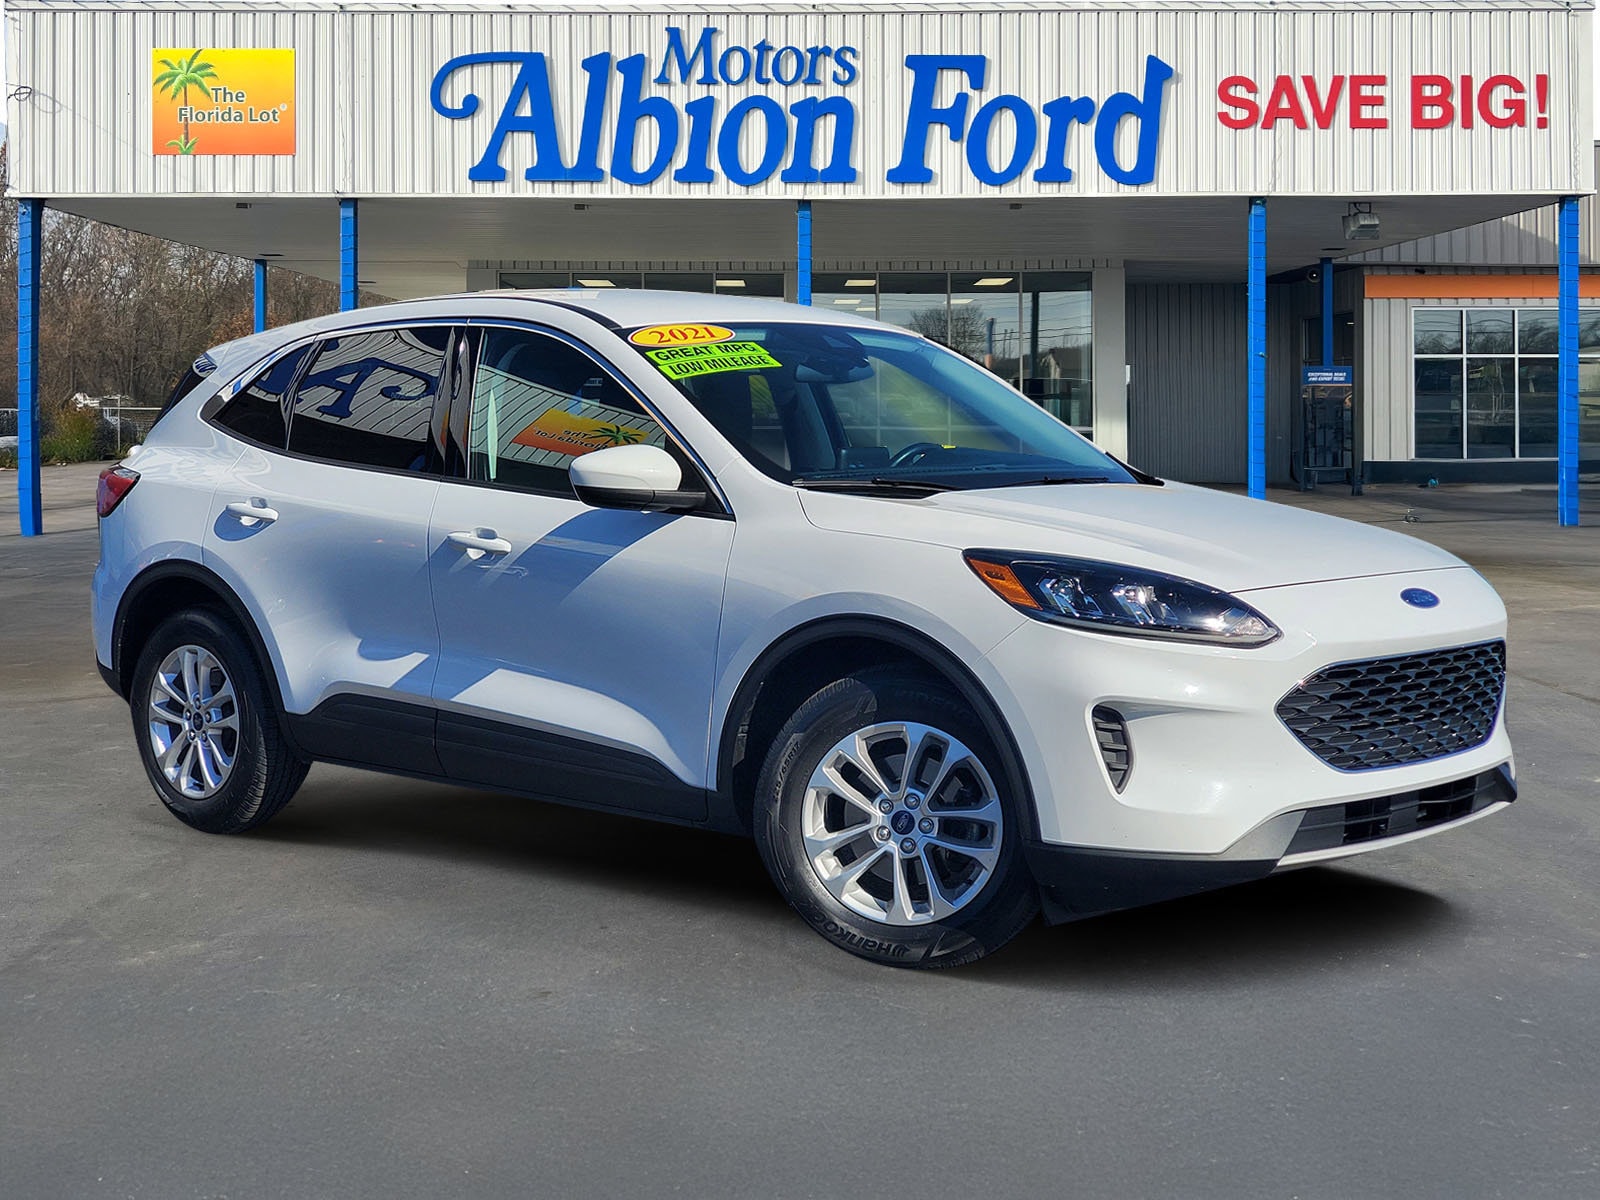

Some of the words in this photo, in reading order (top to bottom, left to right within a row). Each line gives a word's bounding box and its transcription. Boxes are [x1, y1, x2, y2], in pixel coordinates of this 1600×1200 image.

[653, 27, 858, 87] Motors
[210, 86, 245, 103] The
[1218, 75, 1387, 130] SAVE
[1411, 75, 1549, 130] BIG!
[177, 106, 243, 123] Florida
[248, 107, 278, 123] Lot
[431, 51, 857, 187] Albion
[887, 55, 1173, 187] Ford
[649, 326, 717, 344] 2021
[654, 346, 714, 361] GREAT
[719, 343, 756, 354] MPG
[668, 360, 704, 376] LOW
[704, 354, 770, 370] MILEAGE
